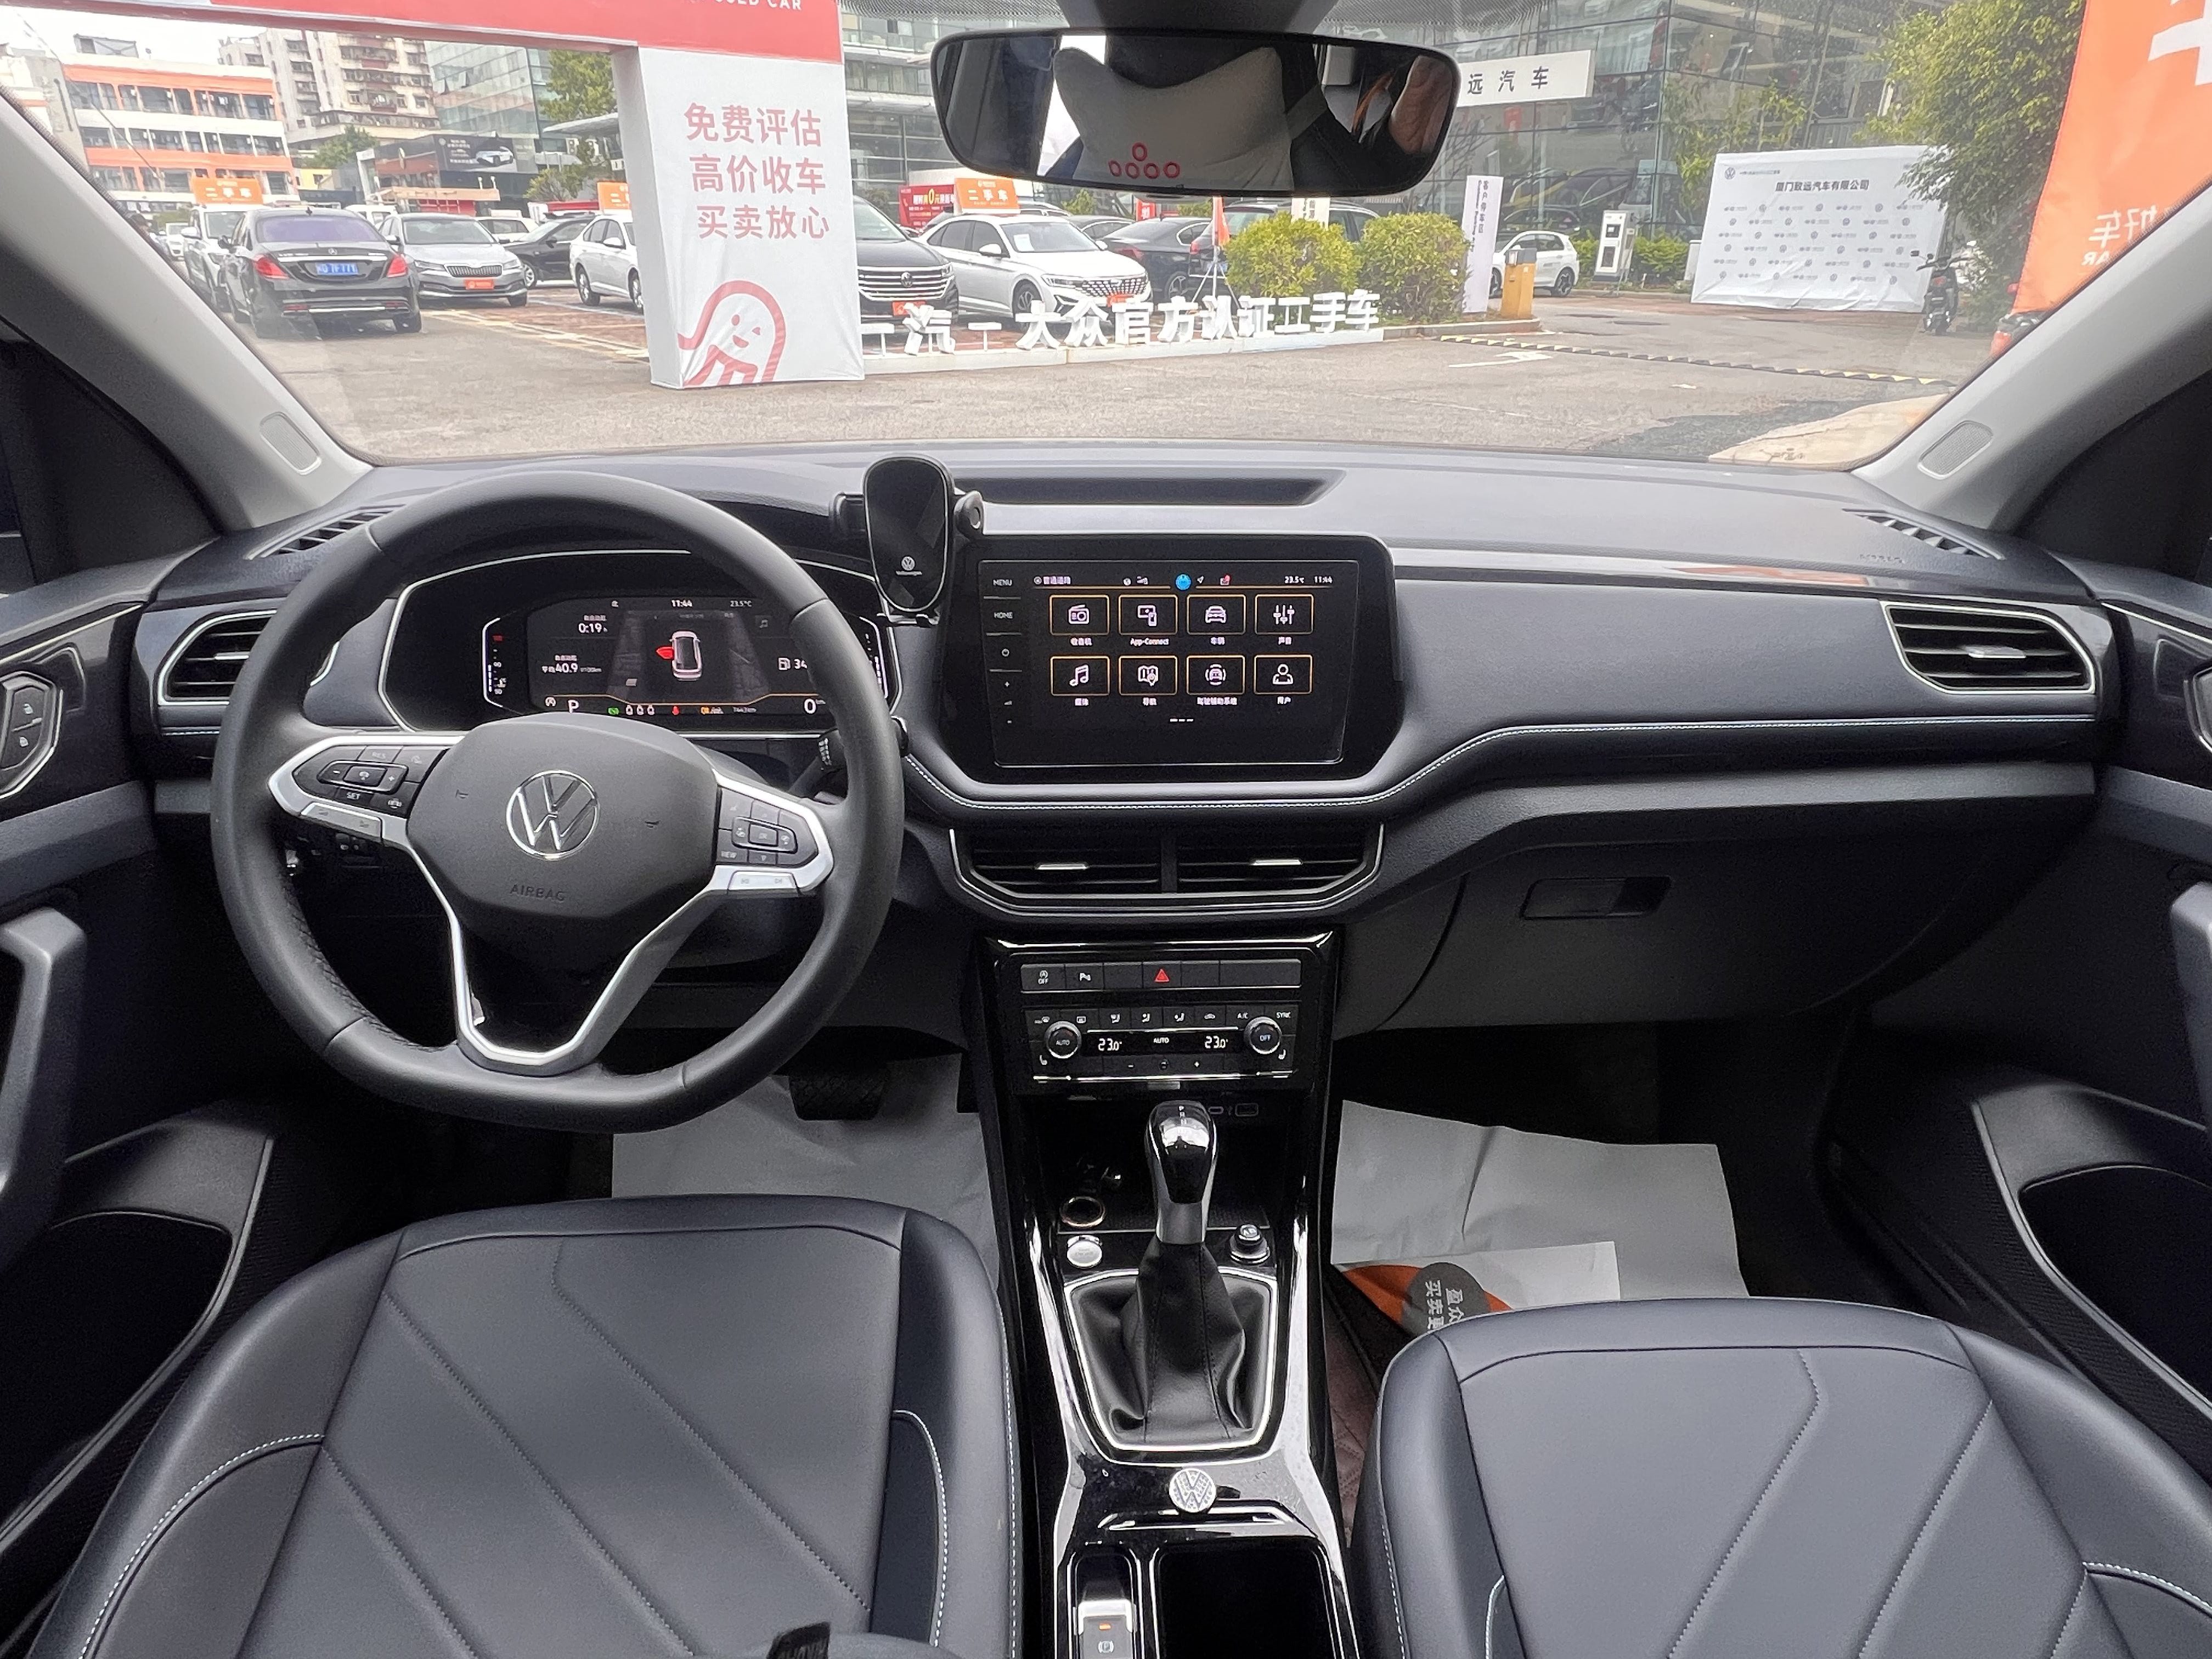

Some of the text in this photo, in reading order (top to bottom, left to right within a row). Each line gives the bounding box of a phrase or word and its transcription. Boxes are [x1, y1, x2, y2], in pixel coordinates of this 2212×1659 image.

[1467, 65, 1549, 96] 远汽车
[684, 102, 822, 148] 免费评估
[689, 154, 826, 195] 高价收车
[697, 205, 830, 239] 买卖放心
[568, 700, 579, 713] P
[804, 698, 816, 714] 0
[346, 792, 361, 800] SET
[509, 883, 567, 902] AIRBAG
